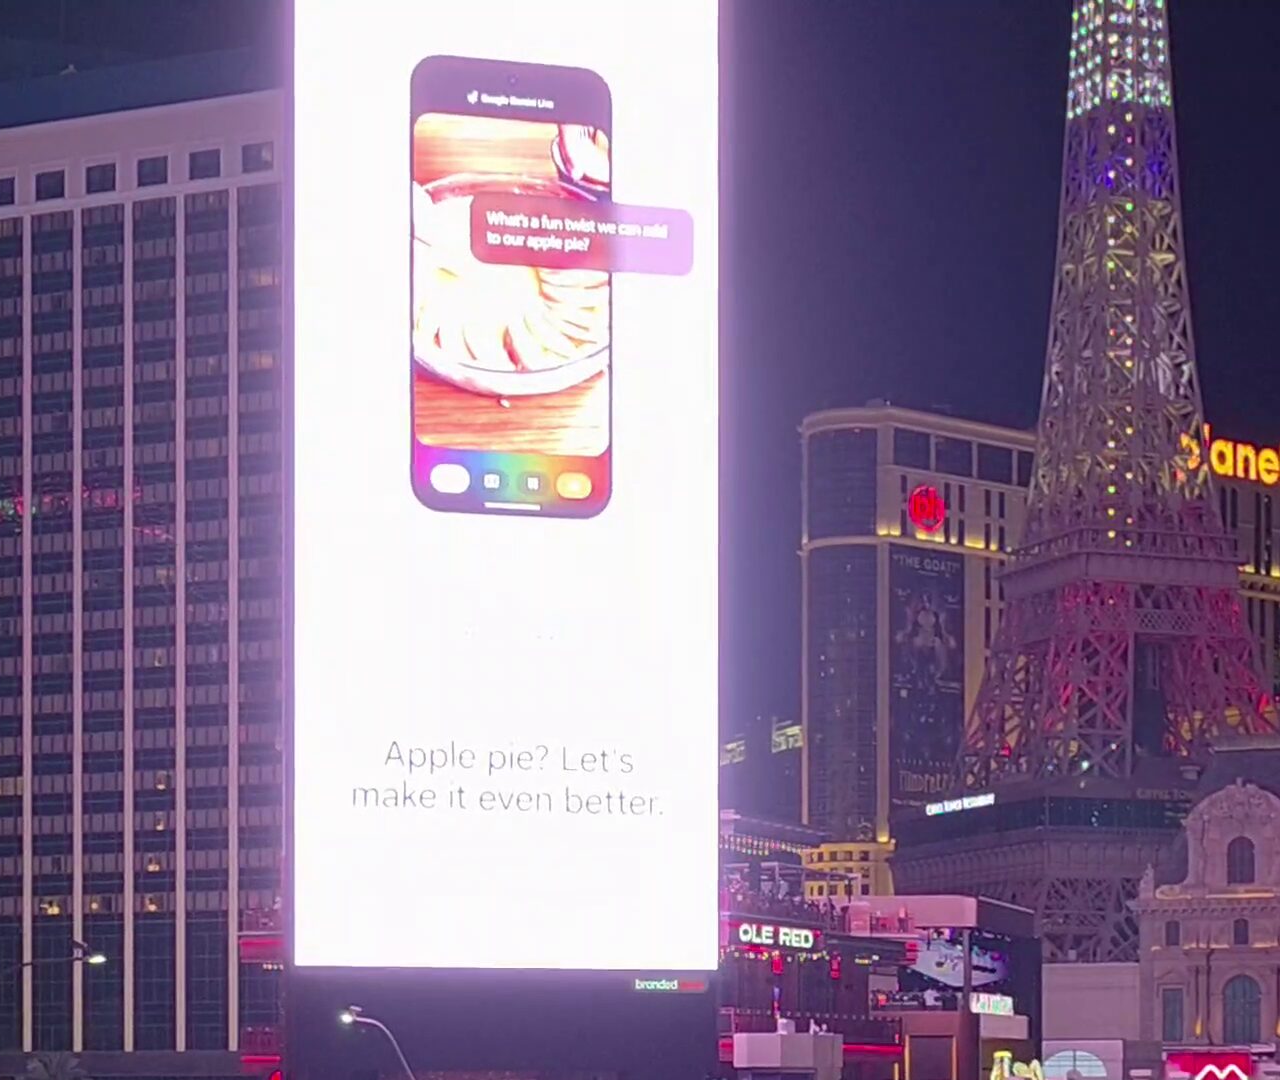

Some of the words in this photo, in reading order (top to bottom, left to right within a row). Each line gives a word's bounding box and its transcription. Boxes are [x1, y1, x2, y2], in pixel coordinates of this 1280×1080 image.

[486, 210, 529, 229] What's
[530, 216, 540, 229] a
[541, 215, 563, 231] fun
[565, 217, 596, 233] twist
[597, 222, 617, 235] we
[486, 231, 501, 244] to
[503, 233, 525, 246] our
[527, 235, 562, 251] apple
[564, 236, 590, 252] pie?
[384, 740, 476, 775] Apple
[488, 741, 549, 777] pie?
[562, 746, 634, 774] Let's
[352, 780, 436, 809] make
[449, 780, 467, 810] it
[479, 790, 552, 812] even
[565, 786, 664, 816] better.
[739, 923, 774, 944] OLE
[779, 926, 814, 949] RED
